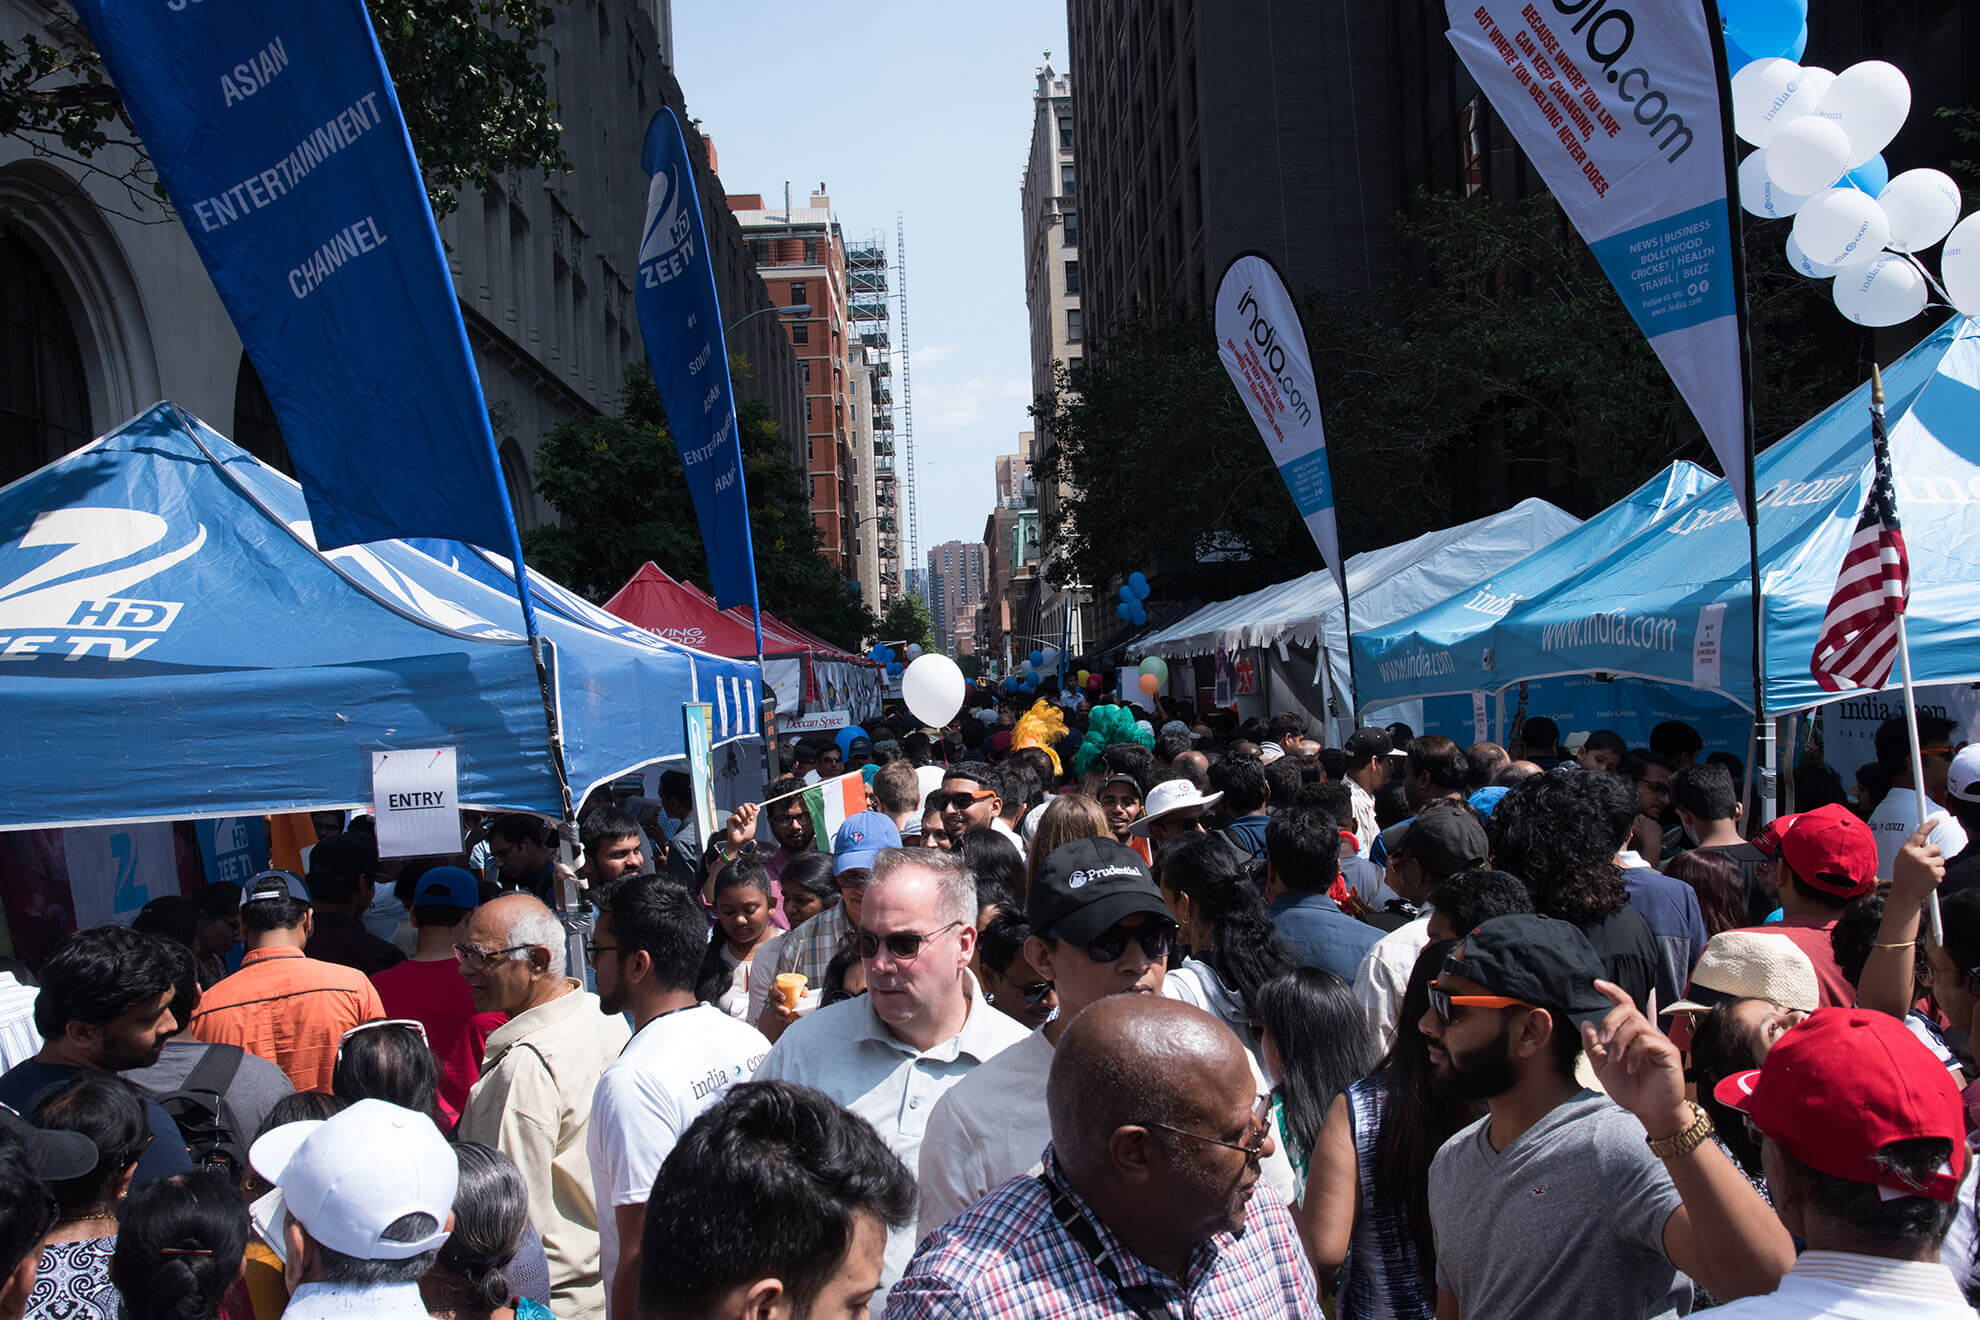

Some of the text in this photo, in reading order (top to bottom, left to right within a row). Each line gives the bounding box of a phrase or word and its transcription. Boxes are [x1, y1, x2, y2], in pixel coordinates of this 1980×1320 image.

[220, 36, 289, 107] ASIAN
[1515, 30, 1597, 144] CAN KEEP CHANGING,
[1521, 3, 1622, 139] BECAUSE WHERE YOU LIVE
[1473, 6, 1610, 199] BUT WHERE YOU BELONG NEVER DOES.
[192, 91, 382, 232] ENTERTAINMENT
[1629, 219, 1712, 254] NEWS BUSINESS
[1640, 237, 1703, 265] BOLLYWOOD
[288, 216, 387, 299] CHANNEL
[640, 254, 683, 289] ZEE
[1631, 246, 1715, 281] CRICKET HEALTH
[1640, 262, 1710, 293] TRAVEL BUZZ
[687, 312, 697, 329] #1
[689, 342, 712, 376] SOUTH
[1237, 285, 1312, 427] india.com
[66, 600, 168, 627] HD
[1542, 606, 1678, 651] www.india.com
[64, 636, 159, 661] TV
[1378, 650, 1455, 683] www.india.com
[786, 716, 818, 729] Deccan
[819, 715, 843, 729] Spice
[1840, 696, 1889, 721] india
[389, 791, 444, 808] ENTRY
[1086, 864, 1143, 882] Prudential
[690, 1068, 729, 1100] india
